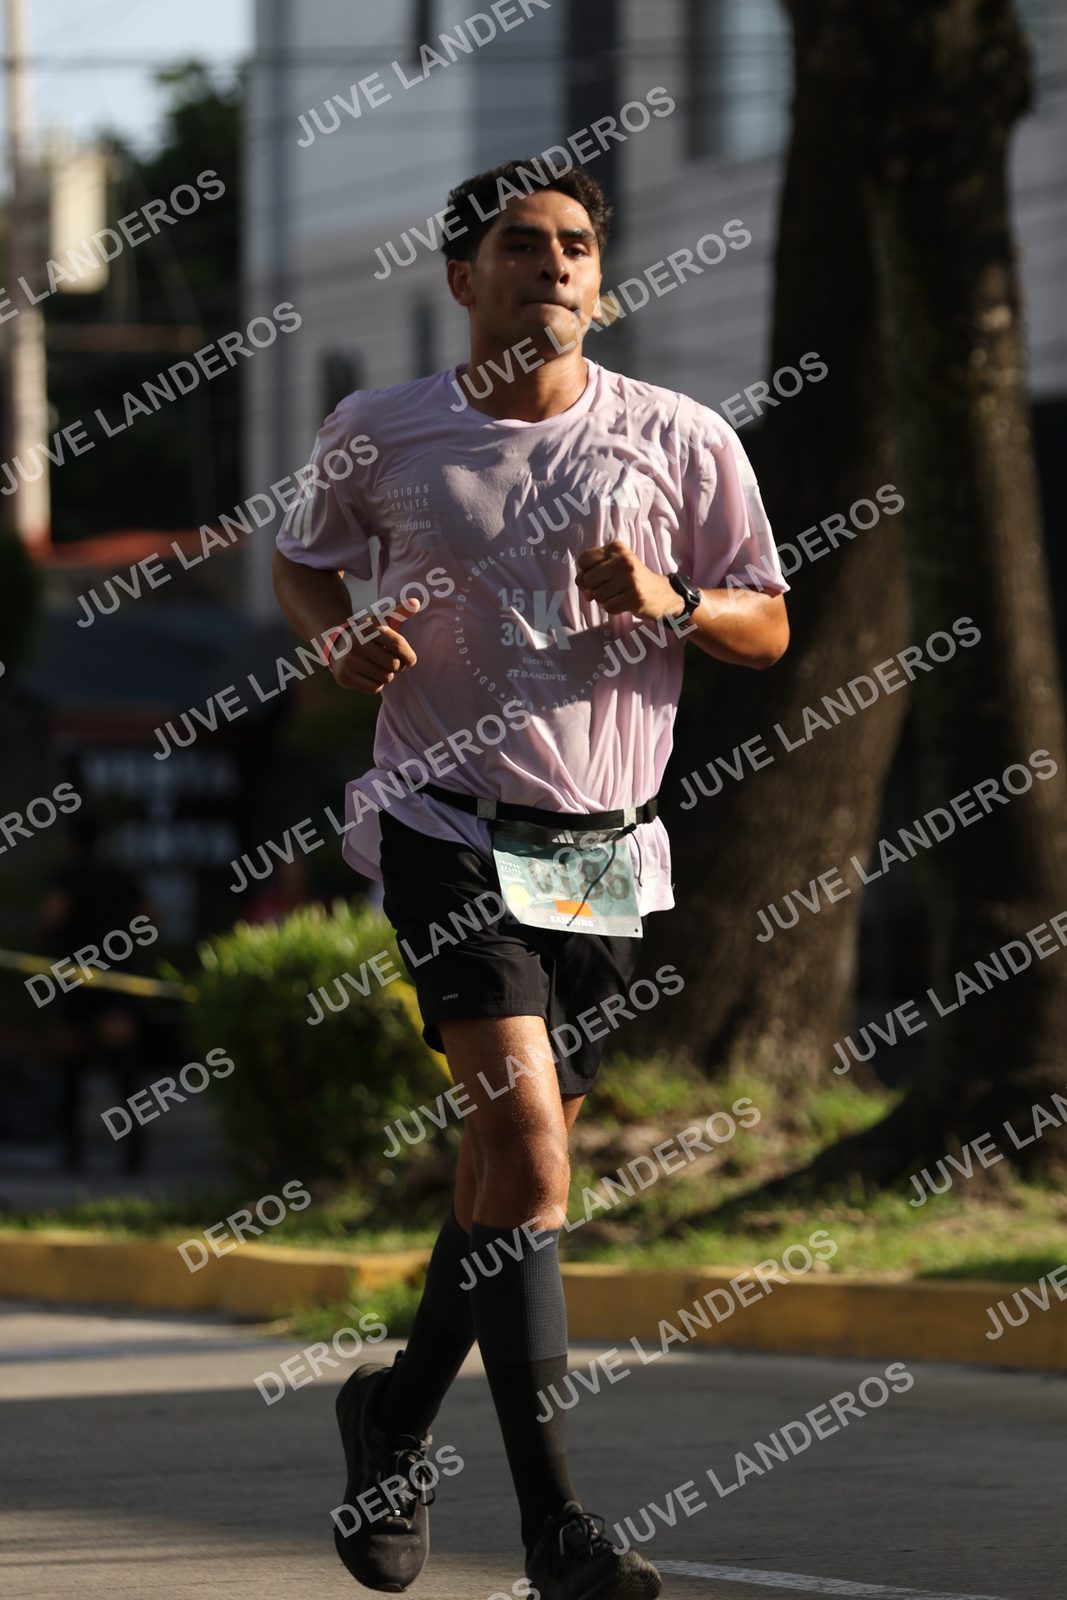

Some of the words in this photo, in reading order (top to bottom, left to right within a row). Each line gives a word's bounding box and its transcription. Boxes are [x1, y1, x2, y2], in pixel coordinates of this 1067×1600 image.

[387, 483, 430, 499] ADIDAS
[508, 545, 536, 557] GDL
[497, 588, 527, 613] 15
[533, 590, 572, 650] K
[500, 622, 528, 647] 30
[521, 671, 569, 681] BANORTE
